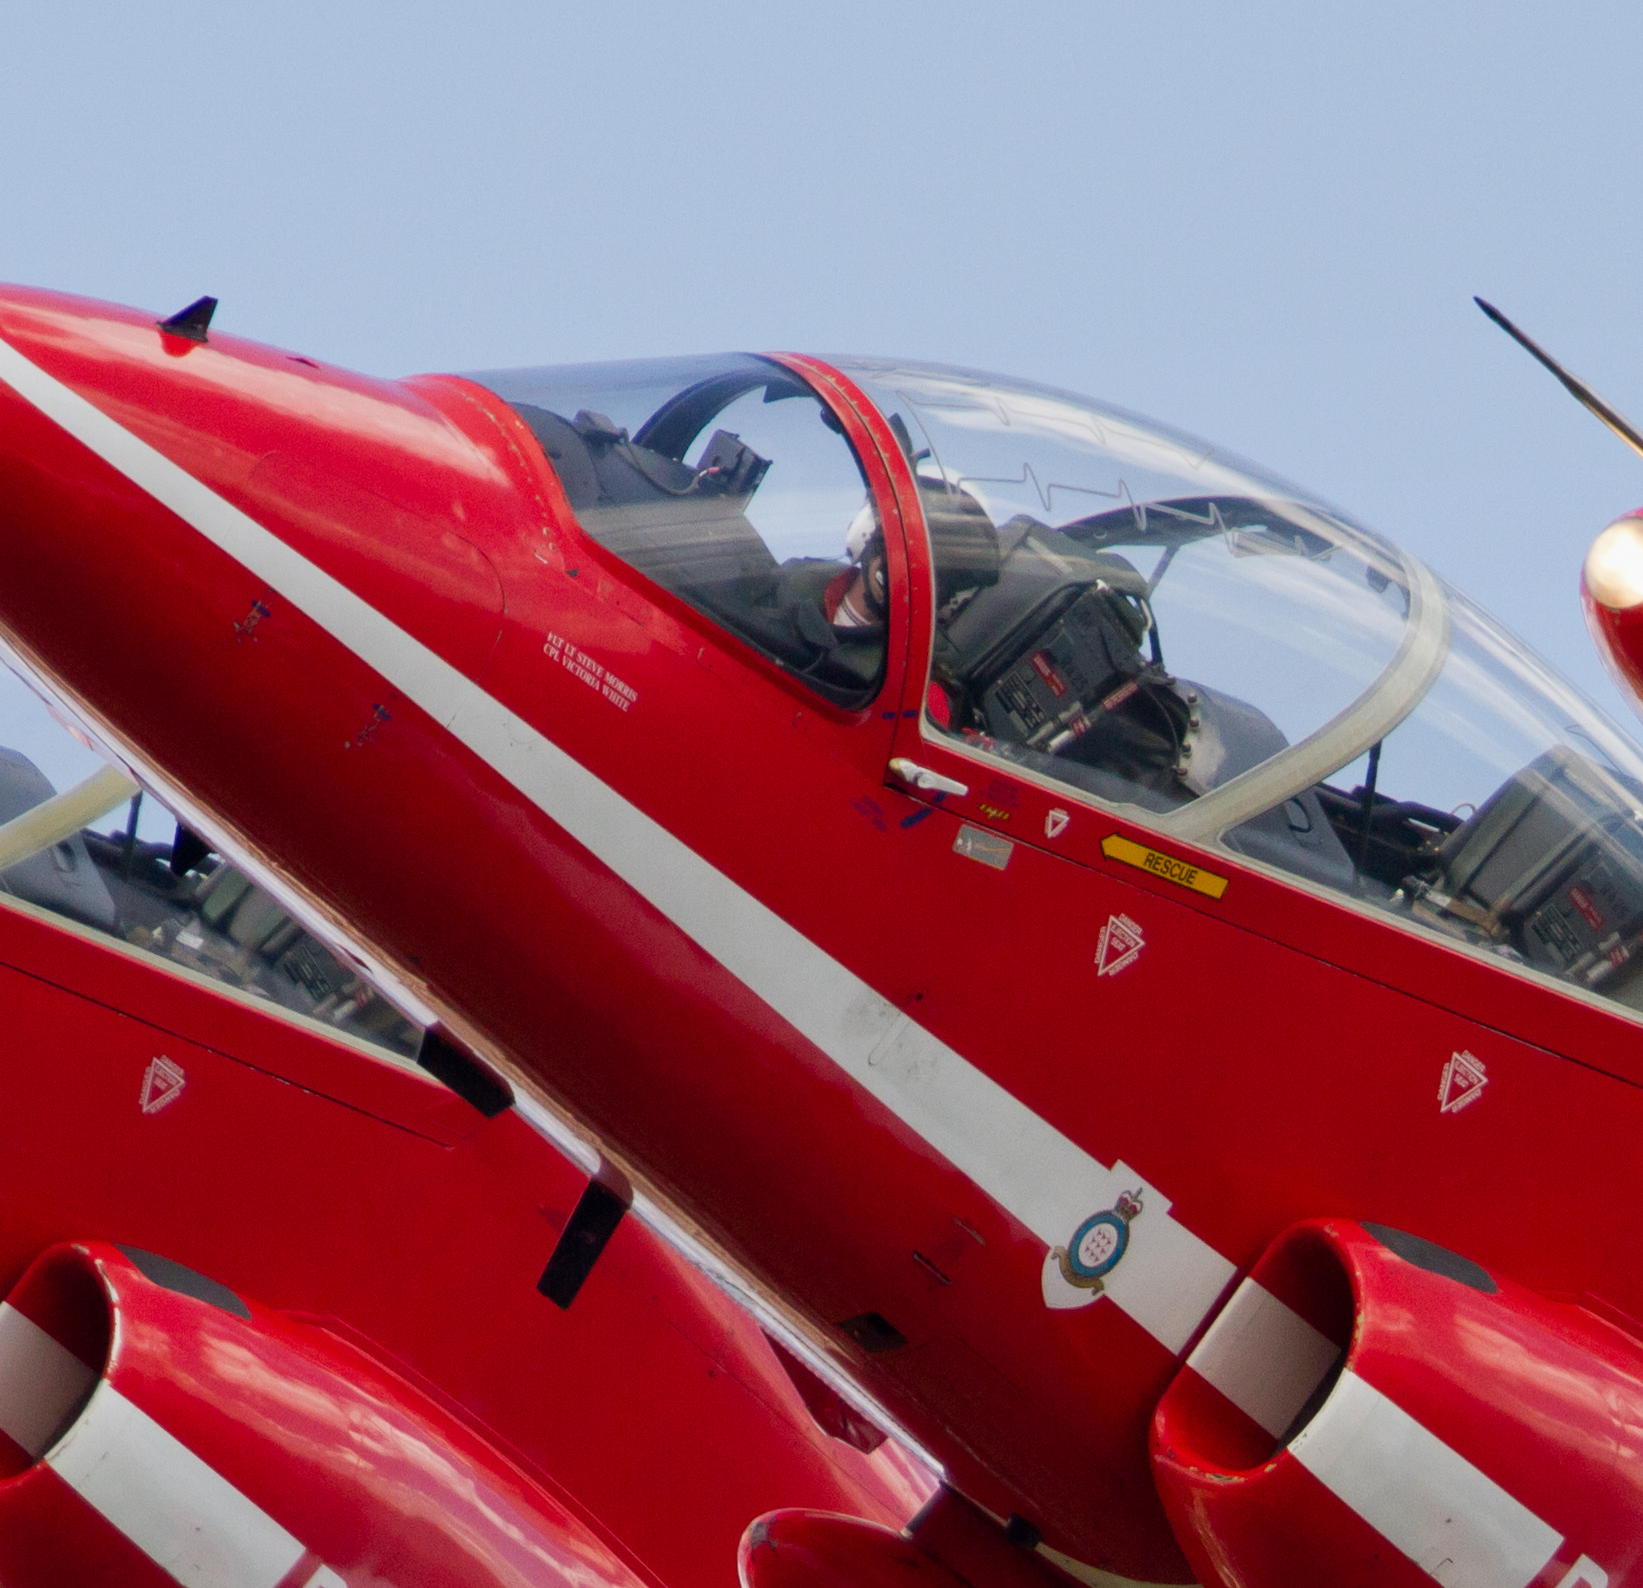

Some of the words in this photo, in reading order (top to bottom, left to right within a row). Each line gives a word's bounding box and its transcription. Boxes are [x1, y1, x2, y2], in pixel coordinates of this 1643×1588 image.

[543, 643, 559, 662] CPL
[562, 655, 600, 691] VICTORIA
[602, 684, 630, 712] WHITE
[564, 643, 577, 658] LT
[577, 651, 604, 678] STEVE
[604, 671, 638, 702] MORRIS
[1143, 852, 1198, 885] RESCUE
